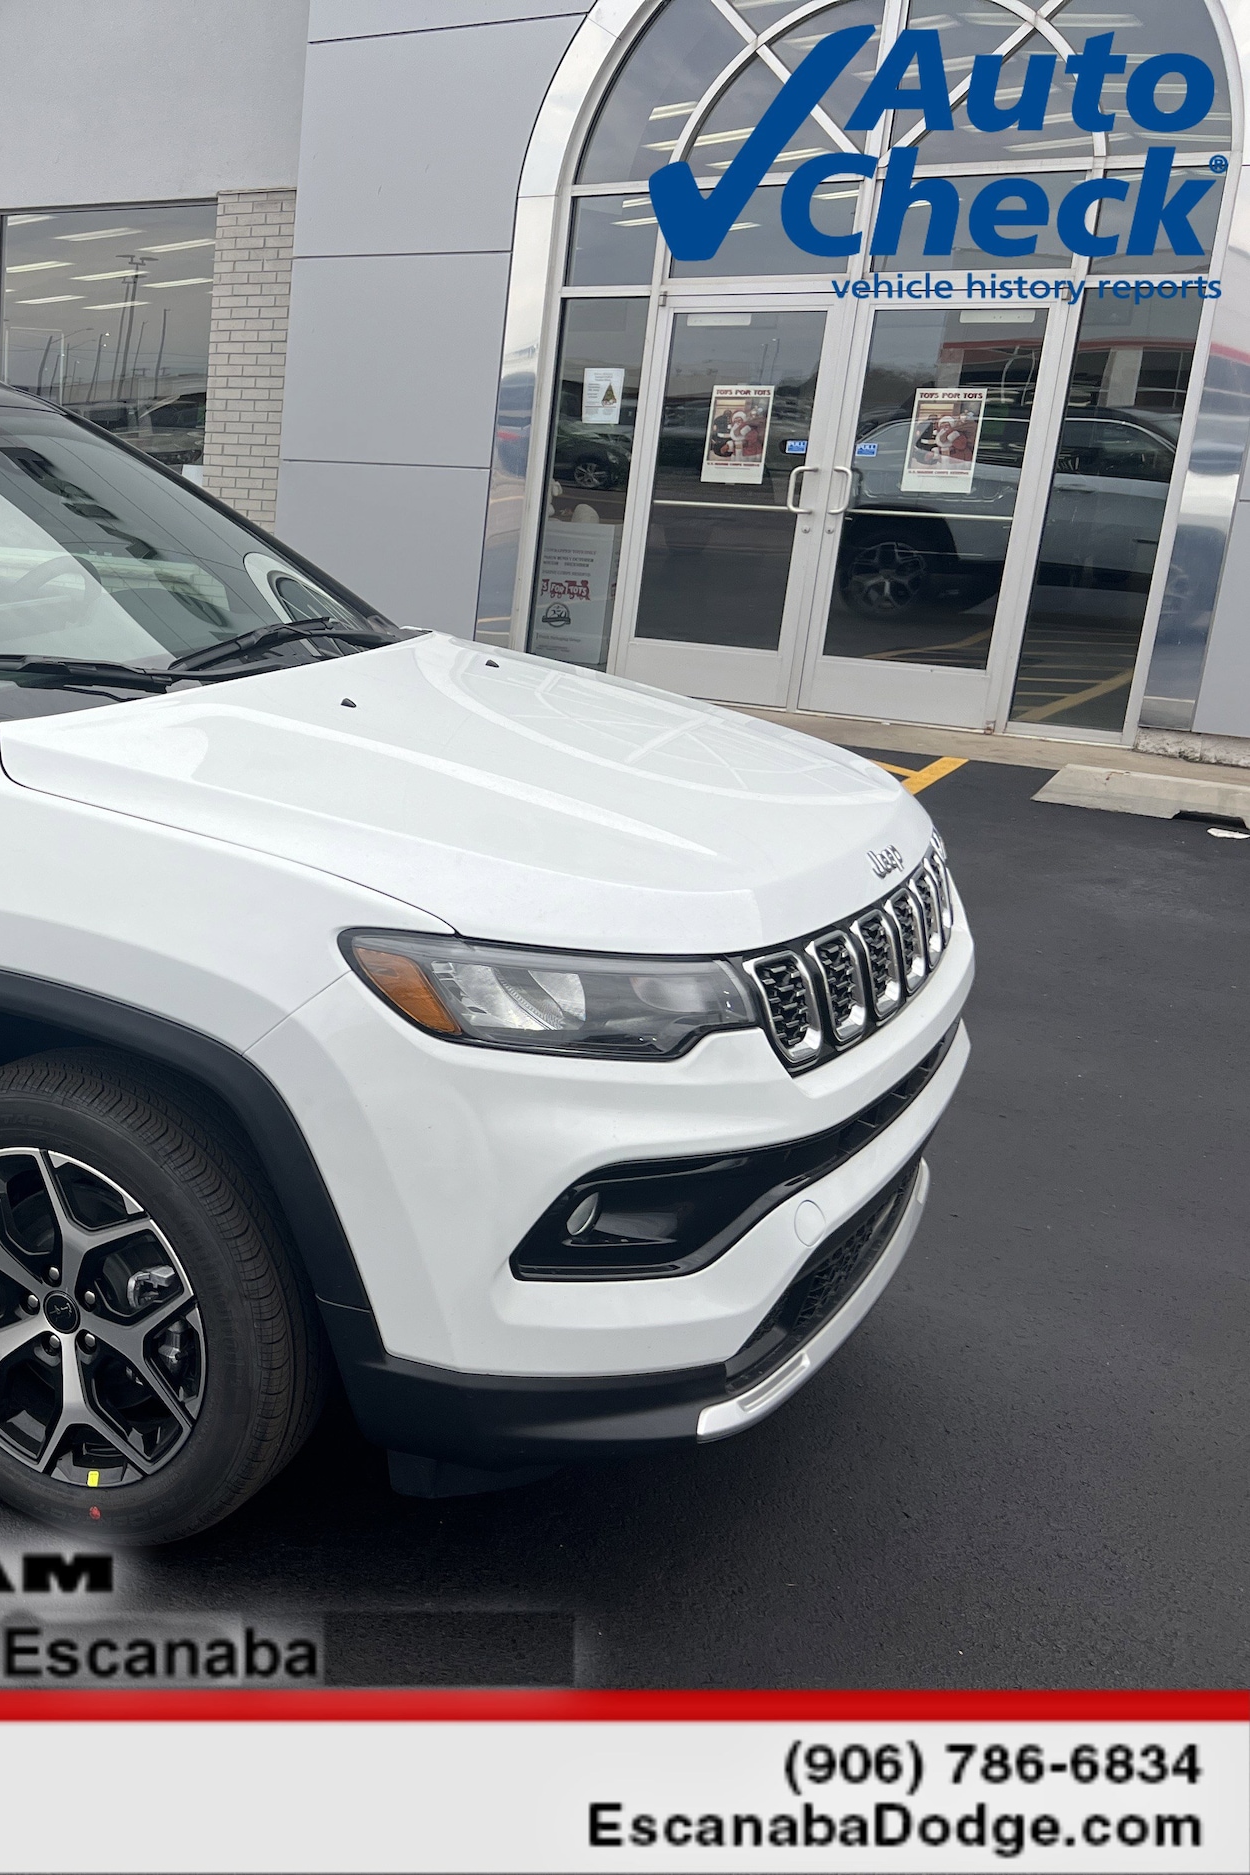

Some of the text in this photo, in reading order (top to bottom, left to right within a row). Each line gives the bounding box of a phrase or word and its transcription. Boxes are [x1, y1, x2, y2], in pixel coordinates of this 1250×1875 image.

[551, 584, 565, 593] FOR
[570, 586, 587, 596] TOTS
[867, 845, 904, 878] Jeep
